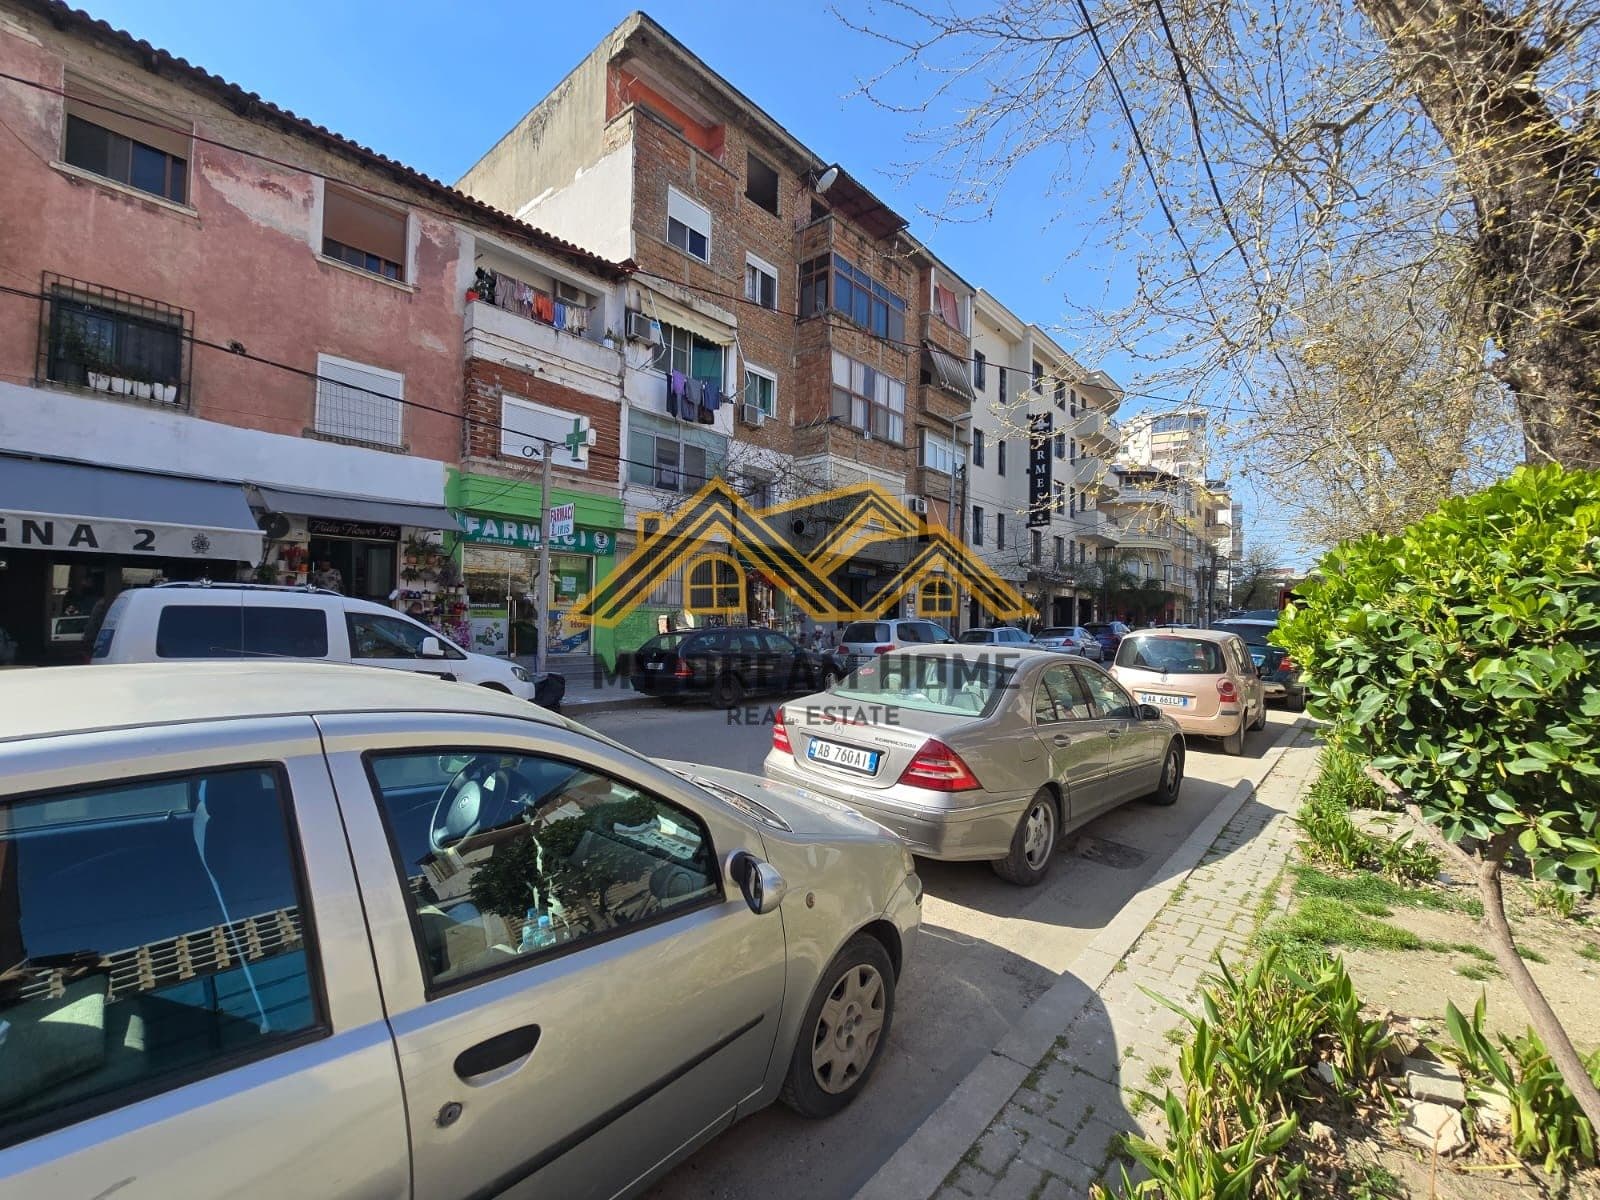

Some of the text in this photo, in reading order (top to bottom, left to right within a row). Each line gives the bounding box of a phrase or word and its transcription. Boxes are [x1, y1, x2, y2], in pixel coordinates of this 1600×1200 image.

[132, 528, 156, 551] 2
[464, 515, 586, 547] FARMCI
[817, 743, 830, 757] AB
